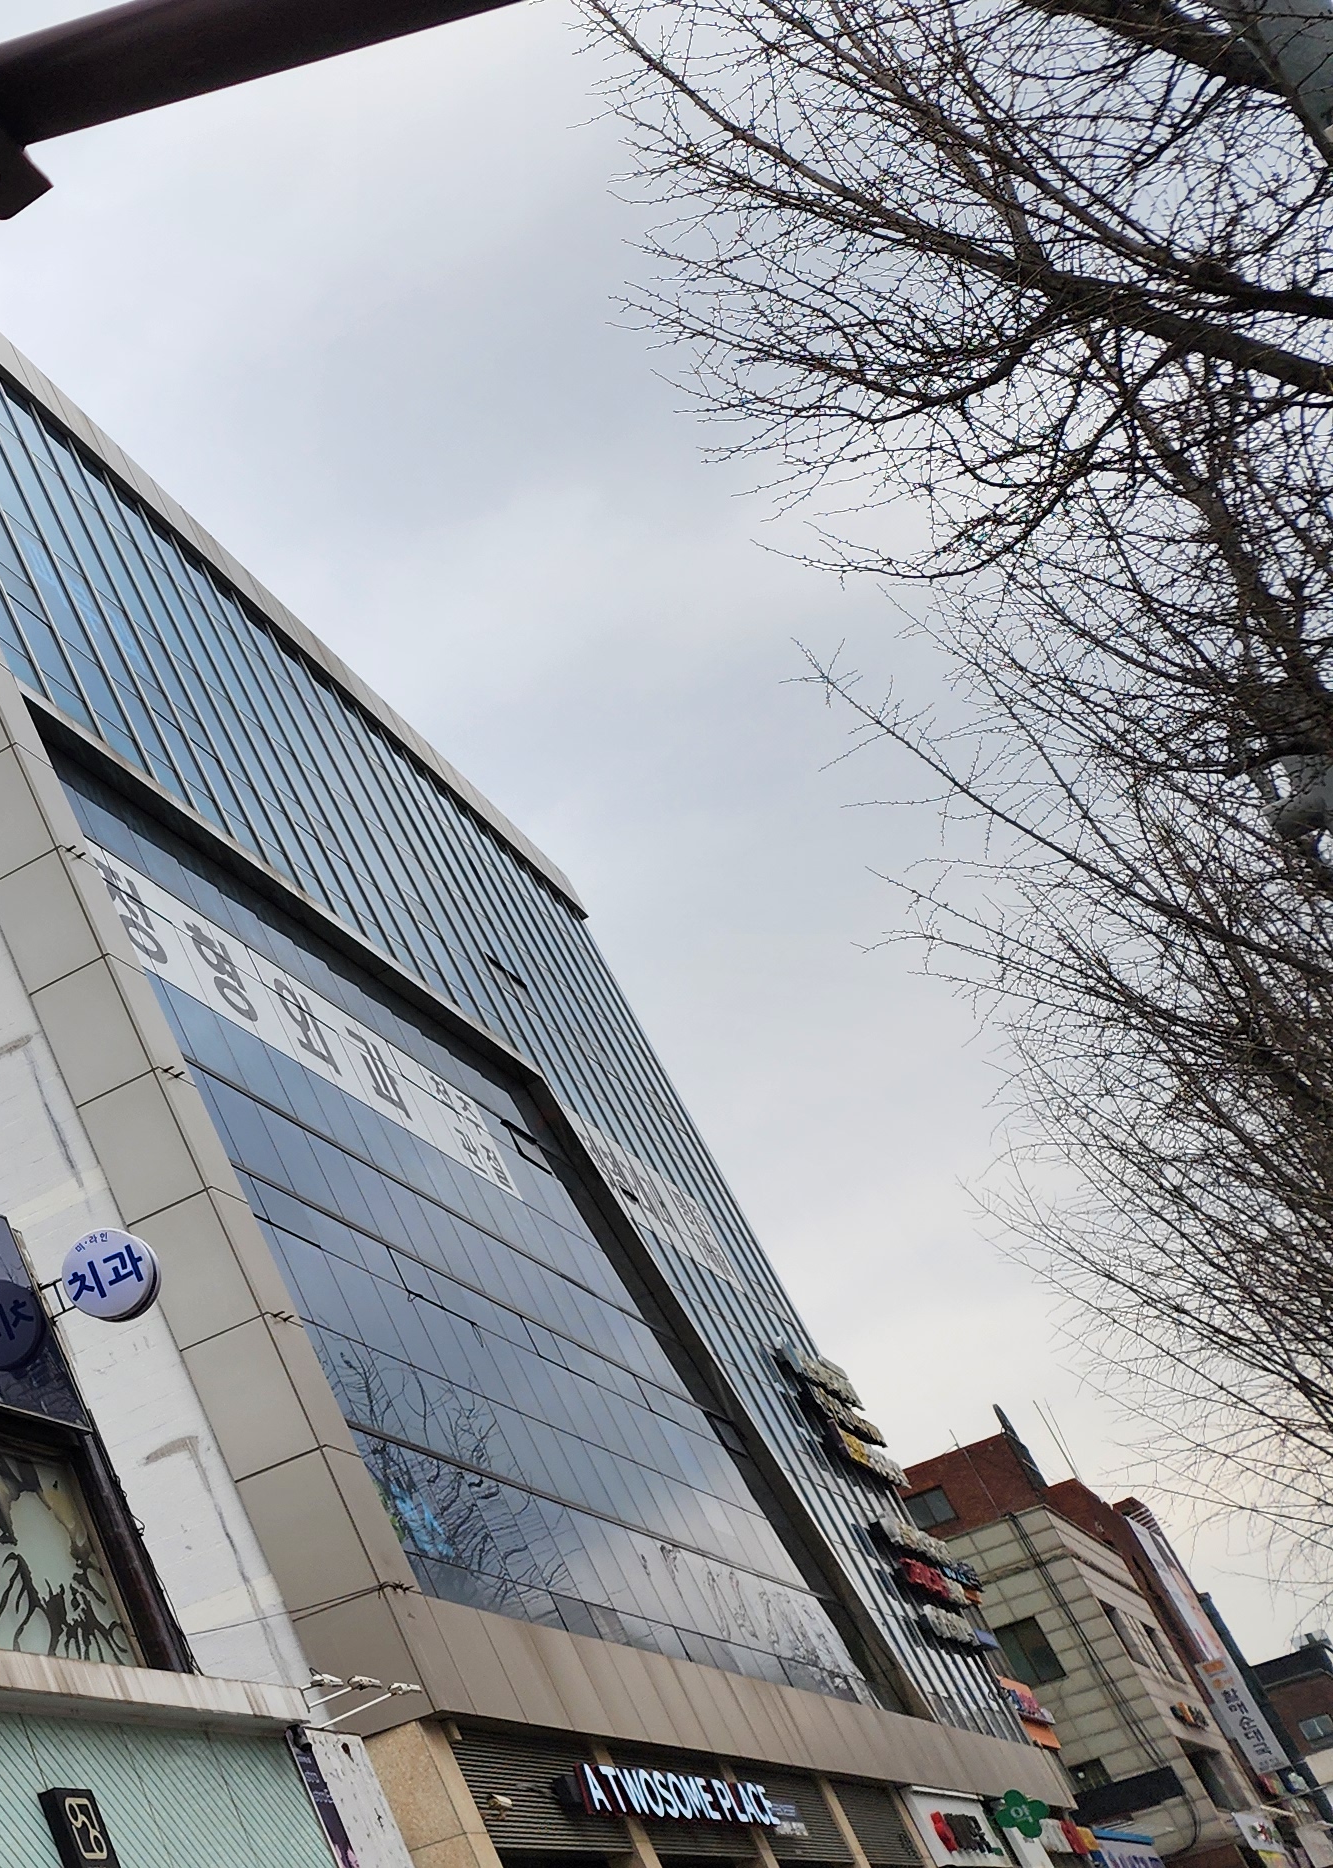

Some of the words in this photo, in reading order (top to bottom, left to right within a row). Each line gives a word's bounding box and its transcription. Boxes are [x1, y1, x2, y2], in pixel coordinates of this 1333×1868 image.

[95, 859, 413, 1122] 정형외과
[68, 1243, 144, 1302] 치과
[583, 1763, 613, 1813] A
[598, 1764, 722, 1820] TWOSOME
[710, 1778, 781, 1826] PLACE
